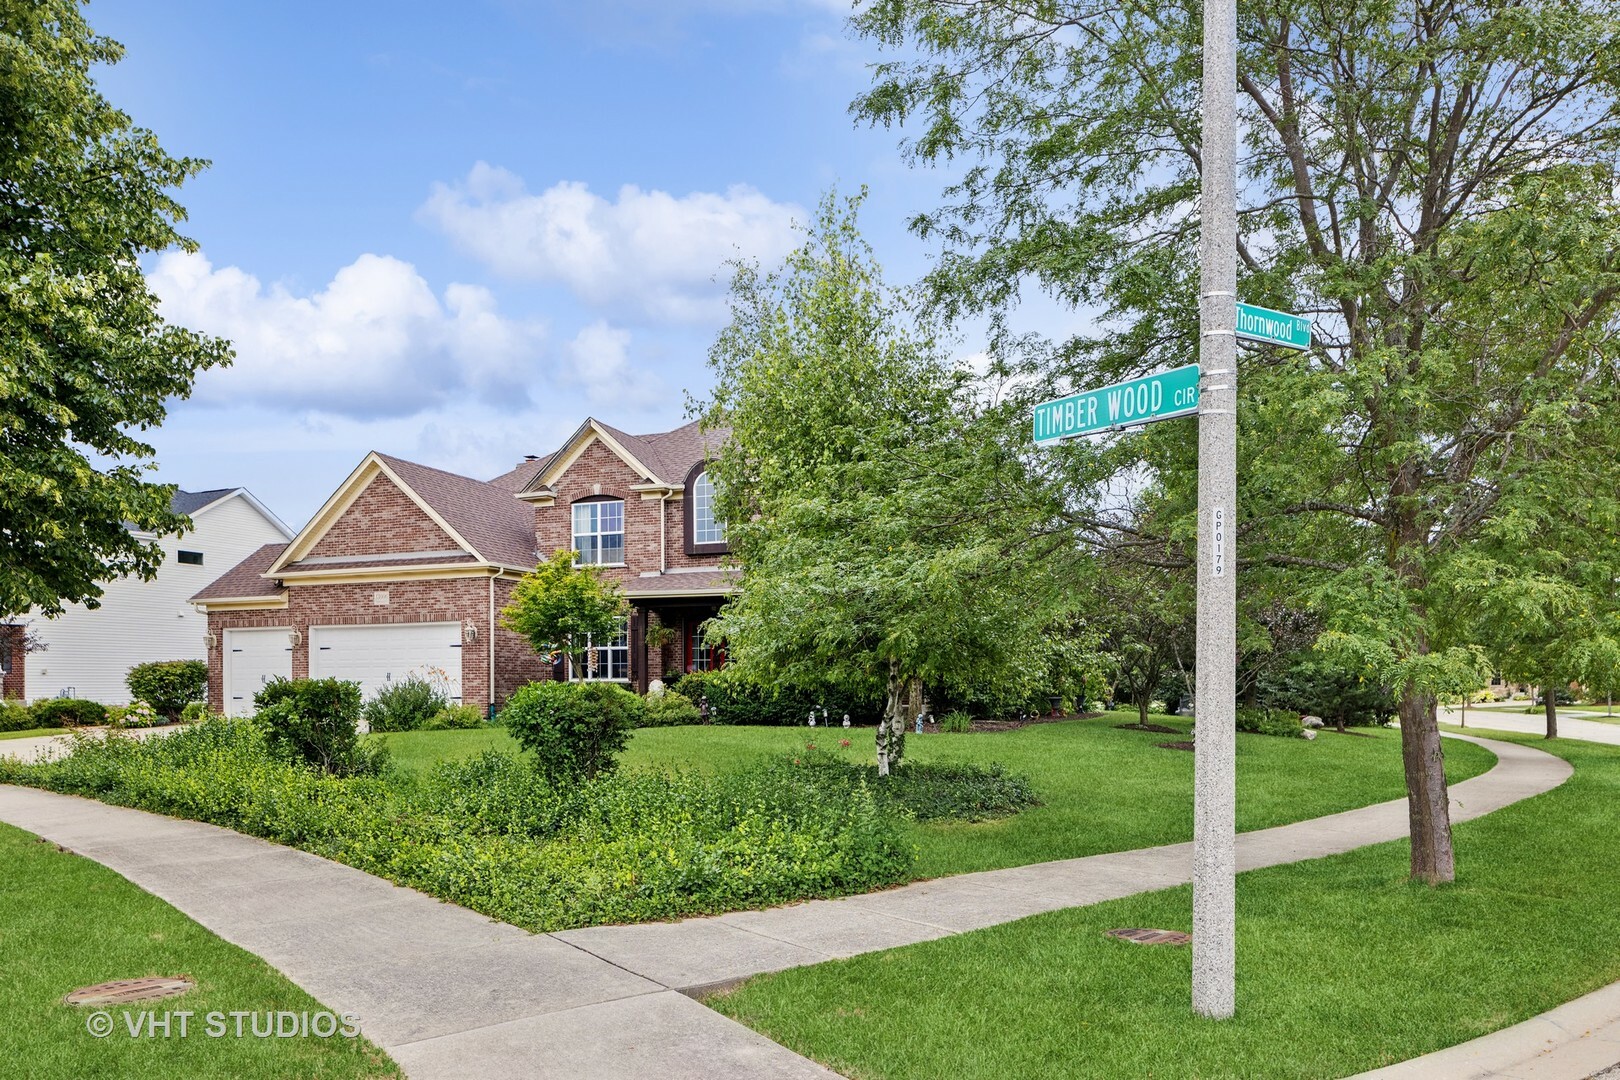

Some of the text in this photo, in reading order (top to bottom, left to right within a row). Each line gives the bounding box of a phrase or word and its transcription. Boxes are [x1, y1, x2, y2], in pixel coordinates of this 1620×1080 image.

[1236, 306, 1310, 340] Thornwood Blvd
[1037, 380, 1195, 437] TIMBER WOOD CIR
